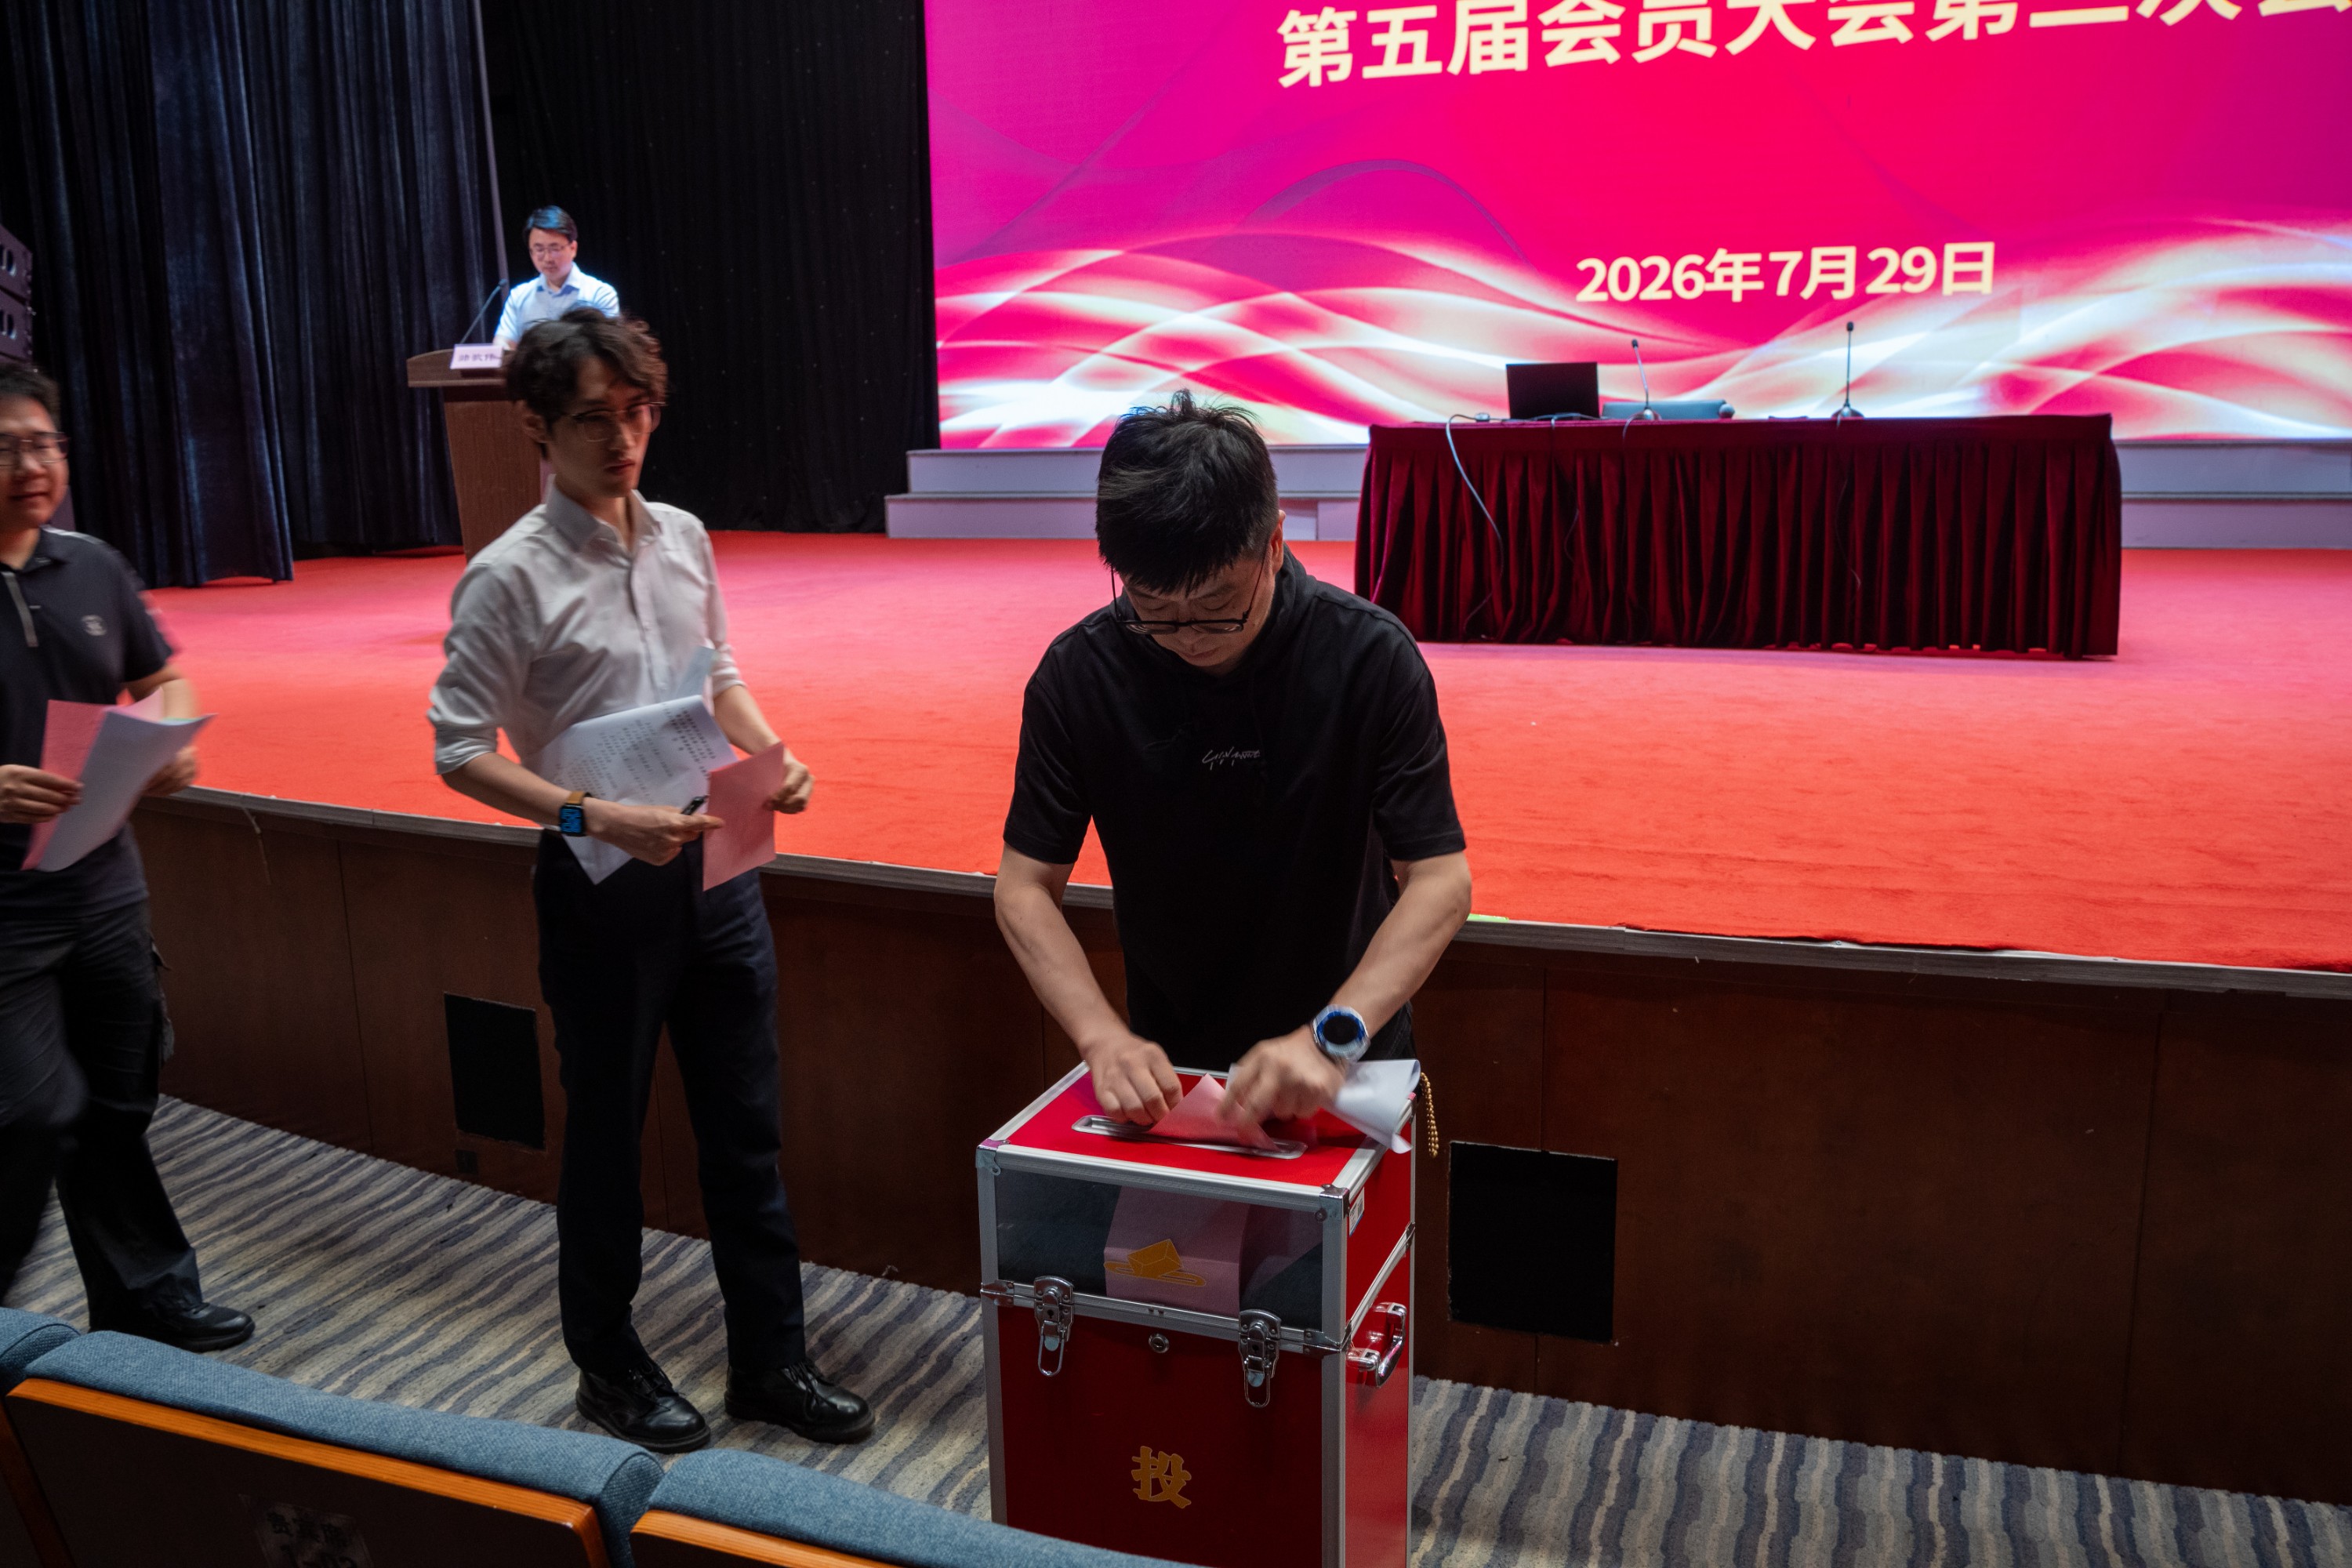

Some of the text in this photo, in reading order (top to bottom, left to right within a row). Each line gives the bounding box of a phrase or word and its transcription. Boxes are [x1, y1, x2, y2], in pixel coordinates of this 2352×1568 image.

[1277, 0, 2352, 88] 第五届会员大会
[1575, 241, 1995, 303] 2026年7月29日
[1131, 1446, 1192, 1509] 投
